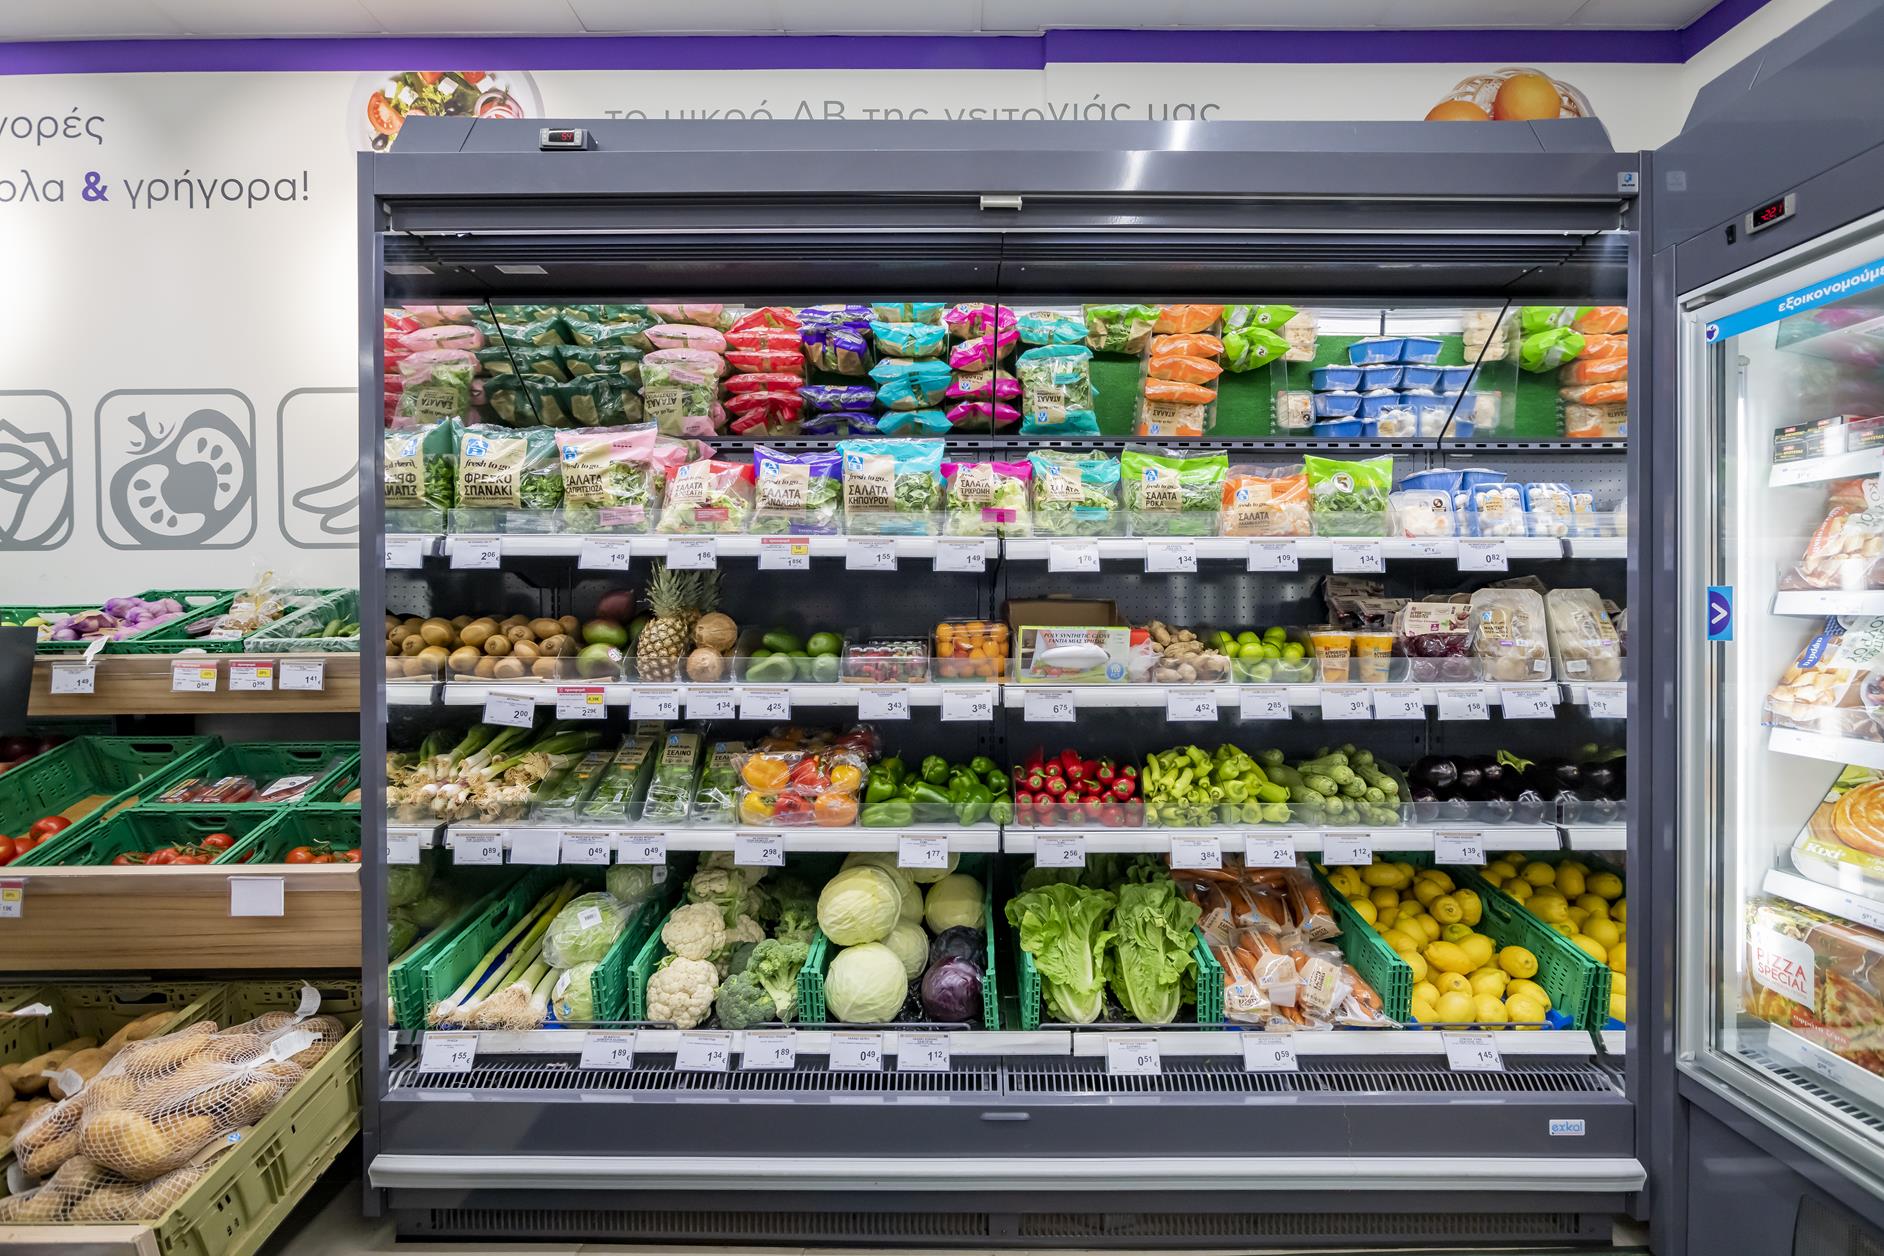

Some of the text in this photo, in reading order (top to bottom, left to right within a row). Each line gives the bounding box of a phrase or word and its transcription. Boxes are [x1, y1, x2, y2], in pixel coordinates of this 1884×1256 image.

[81, 171, 109, 202] &
[123, 169, 310, 210] γρήγορα!
[848, 485, 888, 495] ΣΑΛΑΤΑ
[1146, 492, 1177, 500] ΣΑΛΑΤΑ
[1238, 512, 1270, 521] ΣΑΛΑΤΑ
[1758, 962, 1807, 994] SPECIAL
[1551, 1120, 1583, 1133] exkal
